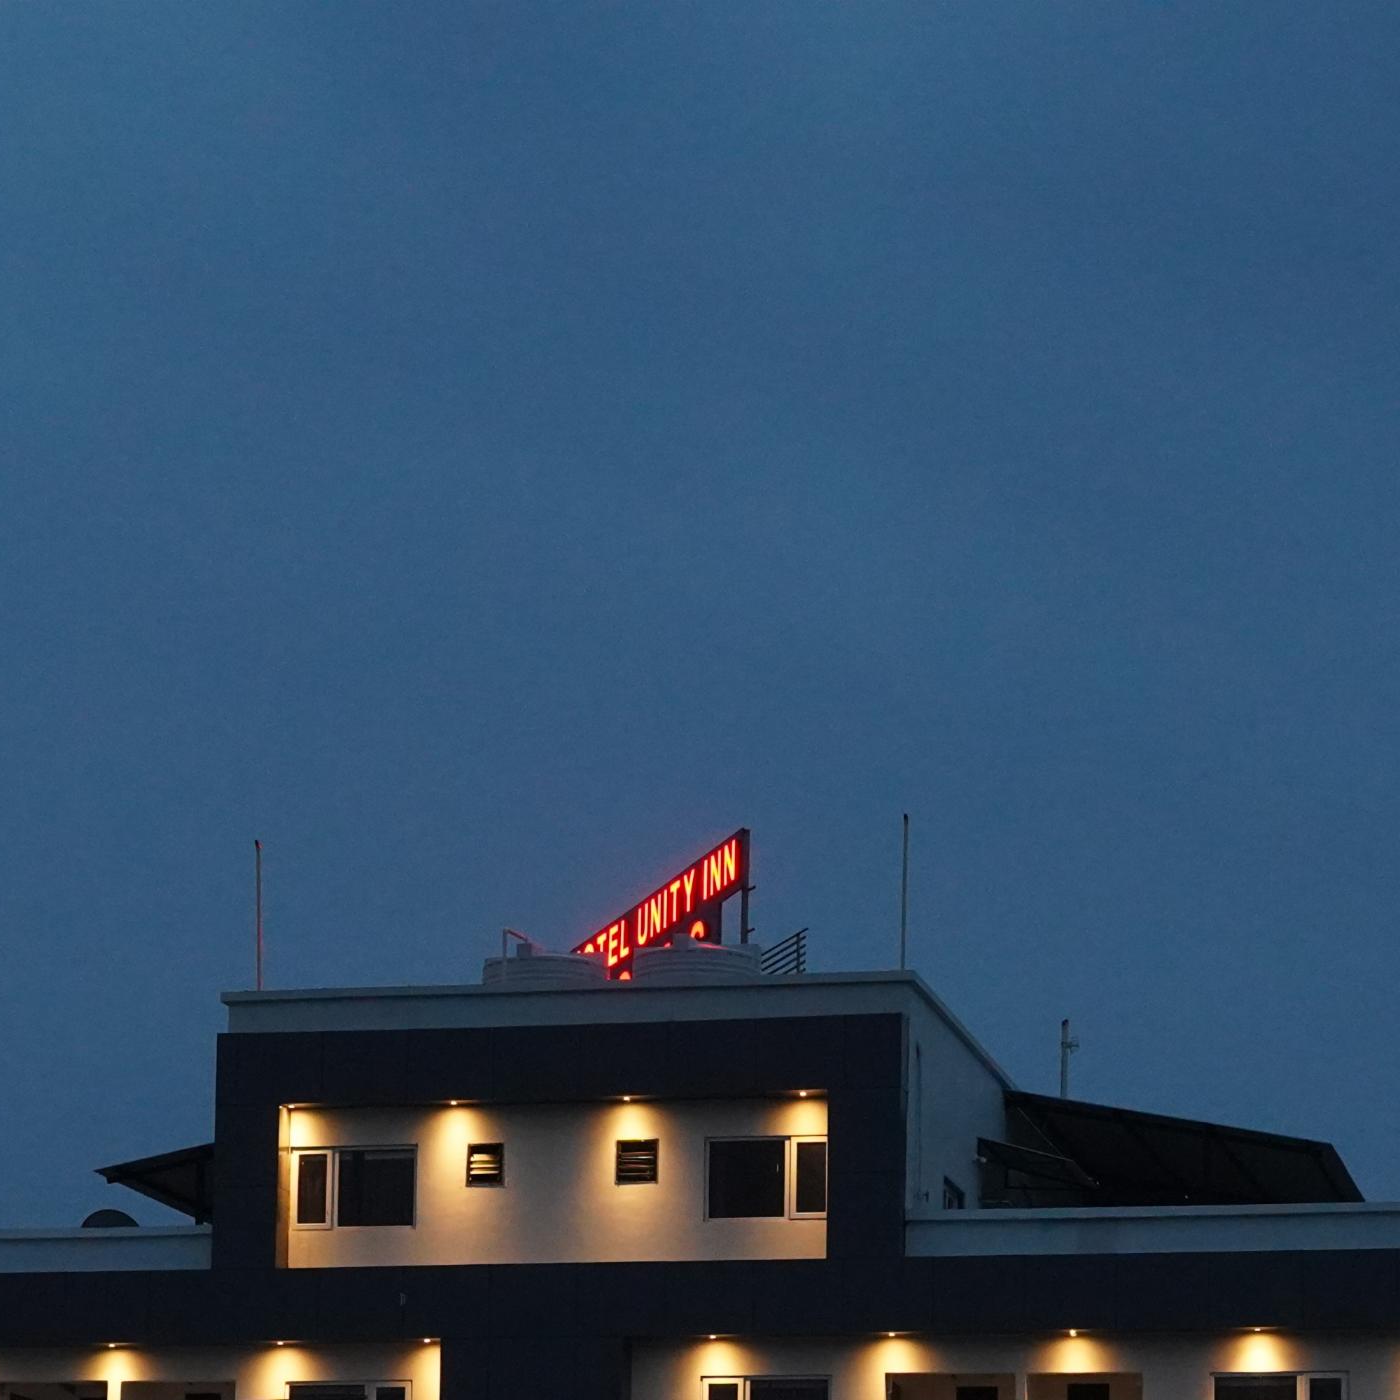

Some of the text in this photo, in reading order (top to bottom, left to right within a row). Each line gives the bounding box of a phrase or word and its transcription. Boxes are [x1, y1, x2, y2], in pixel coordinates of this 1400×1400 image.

[577, 839, 737, 967] TEL UNITY INN
